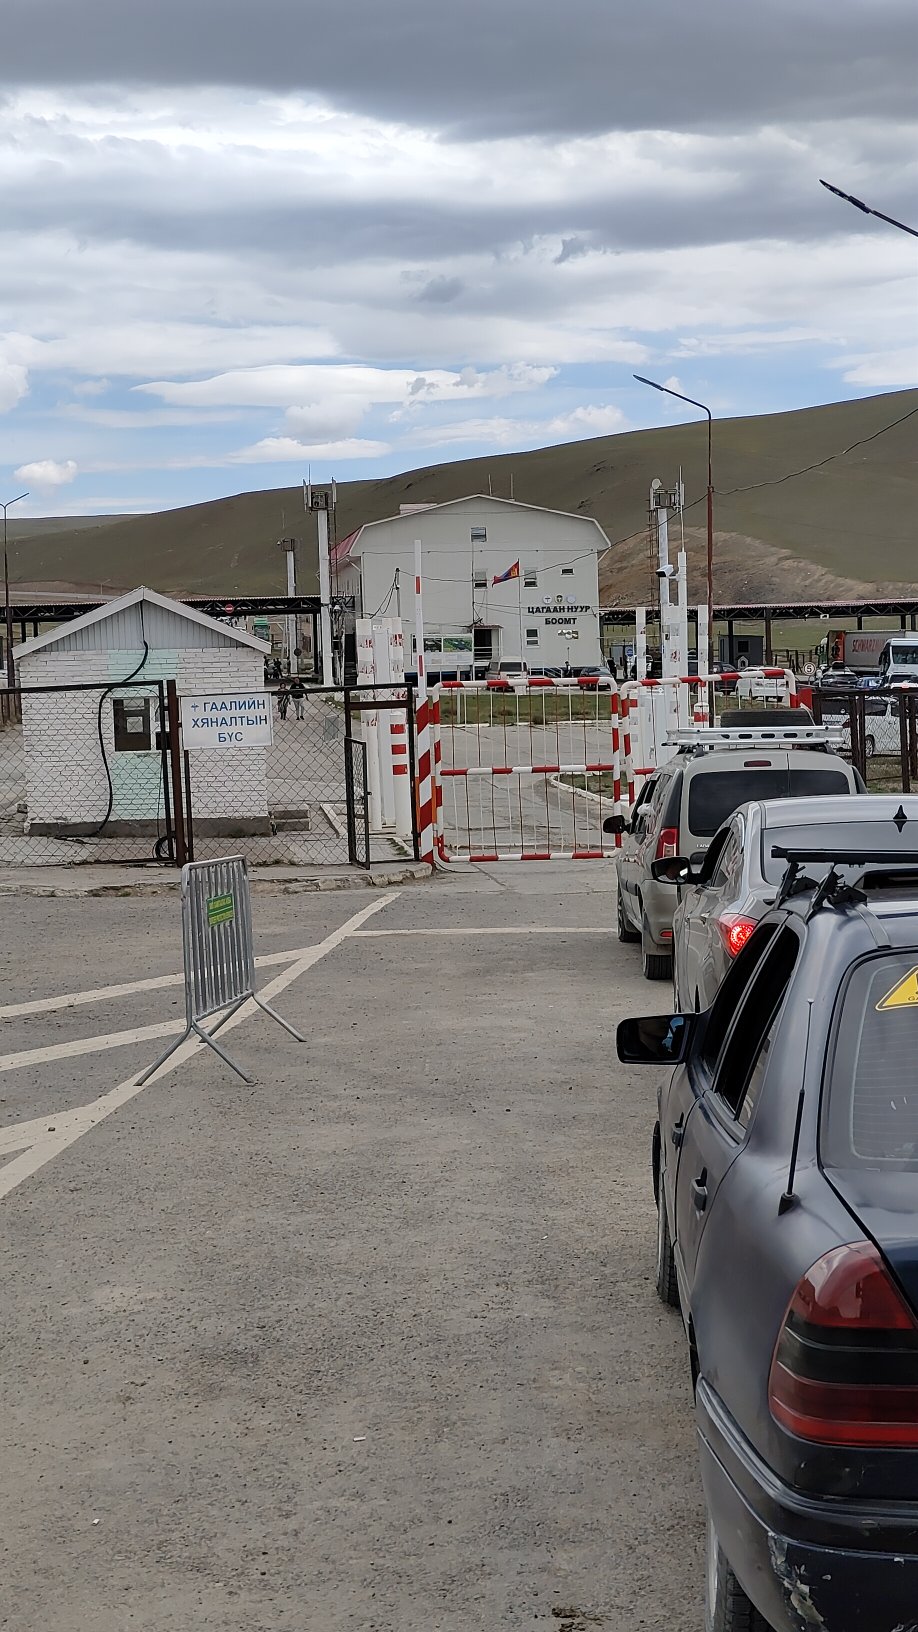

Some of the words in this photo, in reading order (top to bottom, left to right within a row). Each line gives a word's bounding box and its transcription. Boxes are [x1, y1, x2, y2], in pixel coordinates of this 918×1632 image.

[527, 606, 565, 614] ЦАГААН
[545, 617, 578, 625] БООМТ
[203, 697, 266, 712] ГААЛИЙН
[191, 715, 268, 728] ХЯНАЛТЫН
[218, 731, 243, 742] БҮС
